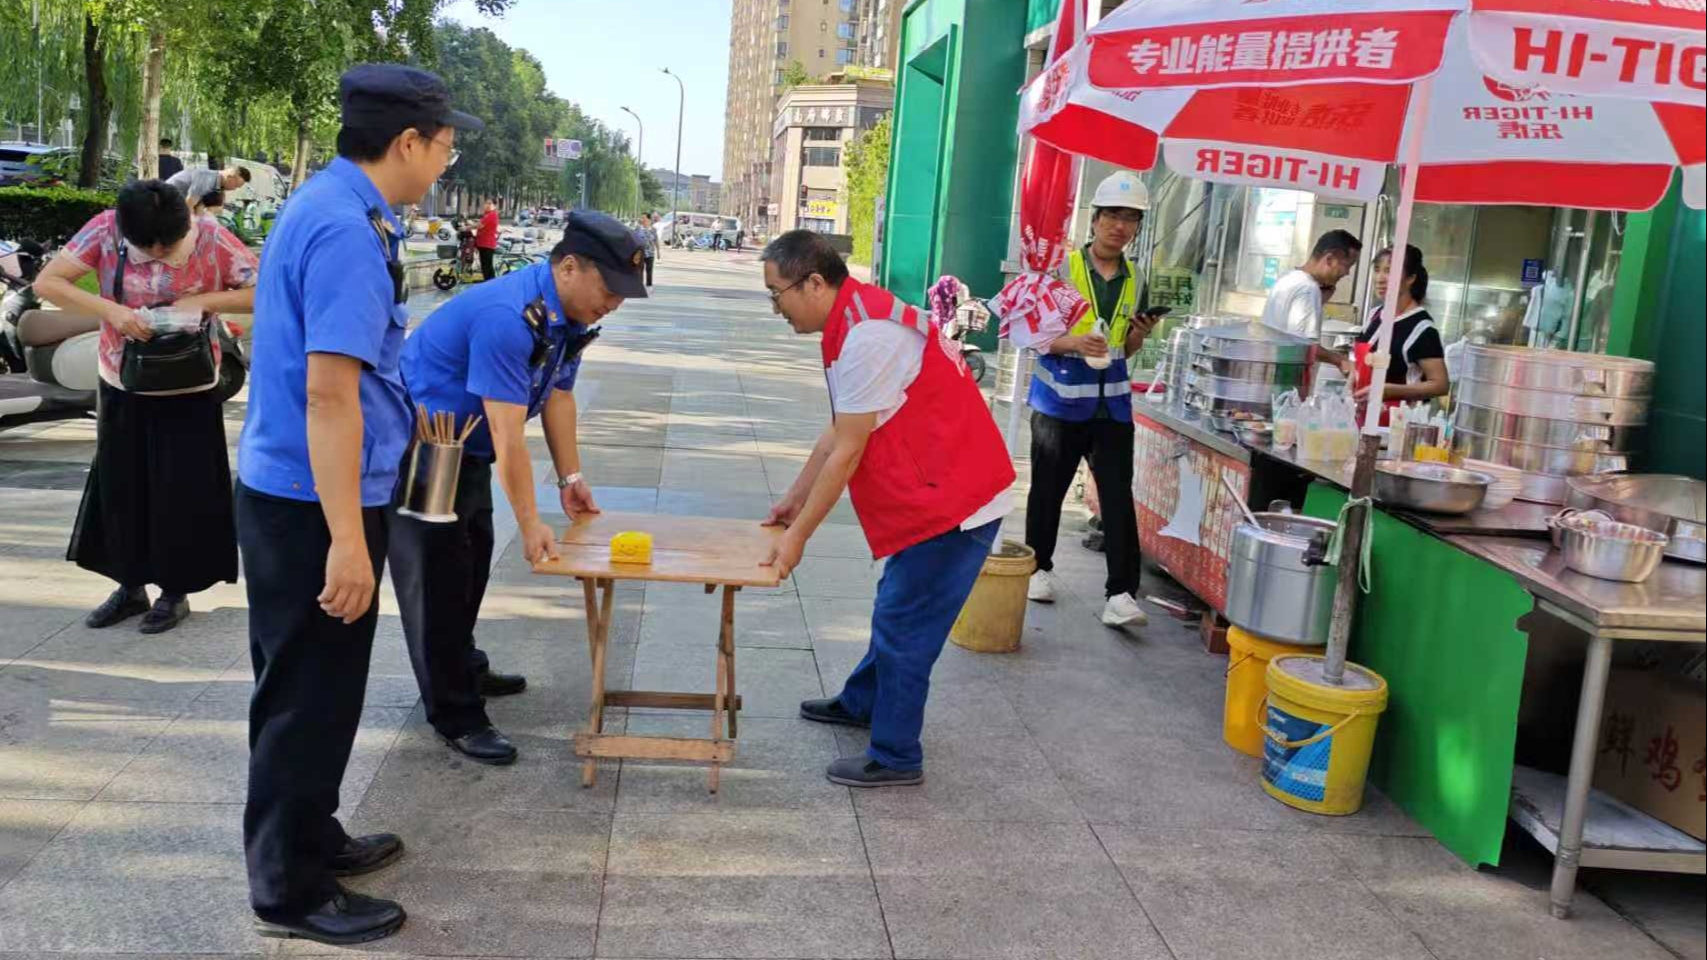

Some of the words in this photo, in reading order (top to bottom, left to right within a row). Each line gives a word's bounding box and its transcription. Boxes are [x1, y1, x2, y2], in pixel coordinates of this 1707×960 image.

[1127, 27, 1400, 75] 专业能量提供者
